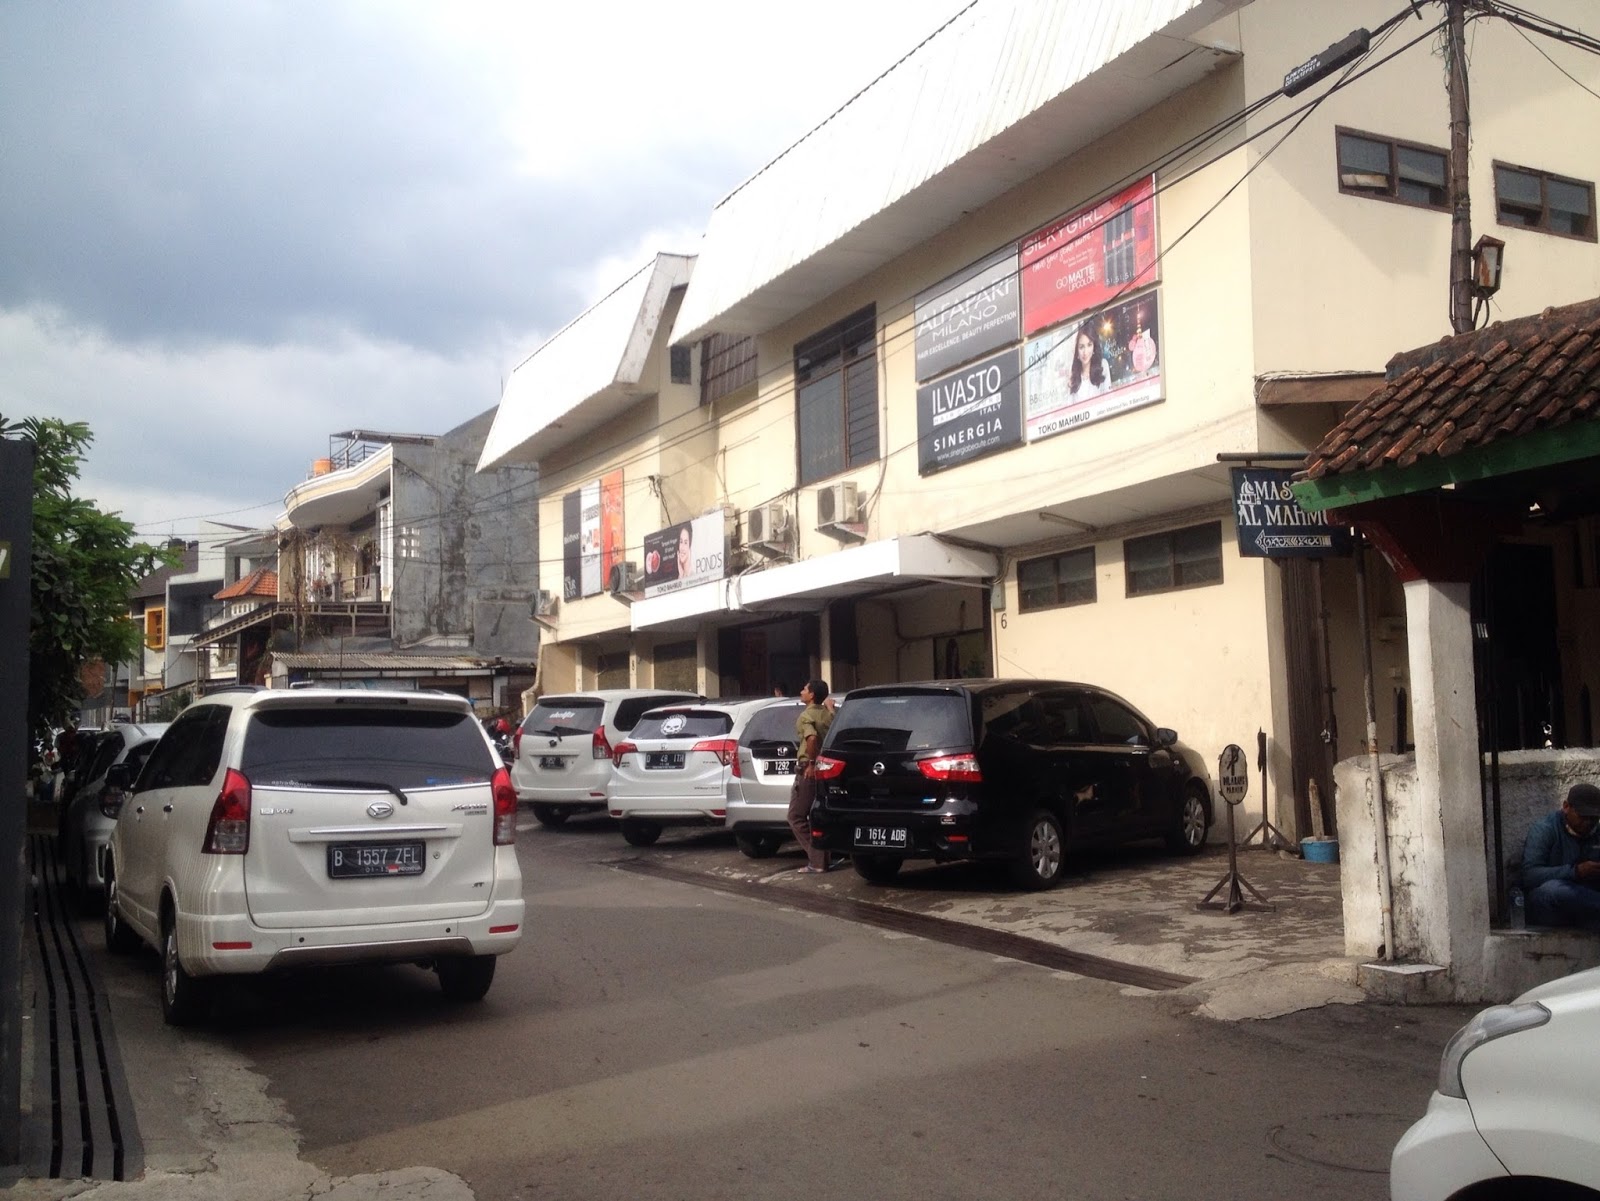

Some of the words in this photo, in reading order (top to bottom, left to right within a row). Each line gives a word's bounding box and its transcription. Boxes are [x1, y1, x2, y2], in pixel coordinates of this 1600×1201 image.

[1023, 208, 1104, 256] SILKYGIRL
[1056, 276, 1068, 289] GO
[1068, 263, 1095, 284] MATTE
[917, 270, 1016, 337] ALFAPARF
[932, 304, 997, 341] MILANO
[961, 325, 982, 341] BEAUTY
[983, 310, 1017, 331] PERFECTION
[932, 365, 1001, 415] ILVASTO
[980, 403, 1002, 416] ITALY
[933, 417, 1002, 452] SINERGIA
[1038, 422, 1057, 435] TOKO
[1058, 411, 1091, 428] MAHMUD
[1254, 481, 1296, 501] MAS
[1238, 504, 1262, 526] AL
[1264, 504, 1328, 526] MAHM
[1001, 612, 1008, 629] 6
[775, 761, 790, 771] 1292
[855, 828, 861, 840] D
[869, 828, 887, 840] 1614
[334, 850, 343, 867] B
[356, 848, 389, 866] 1557
[394, 847, 419, 865] ZFL
